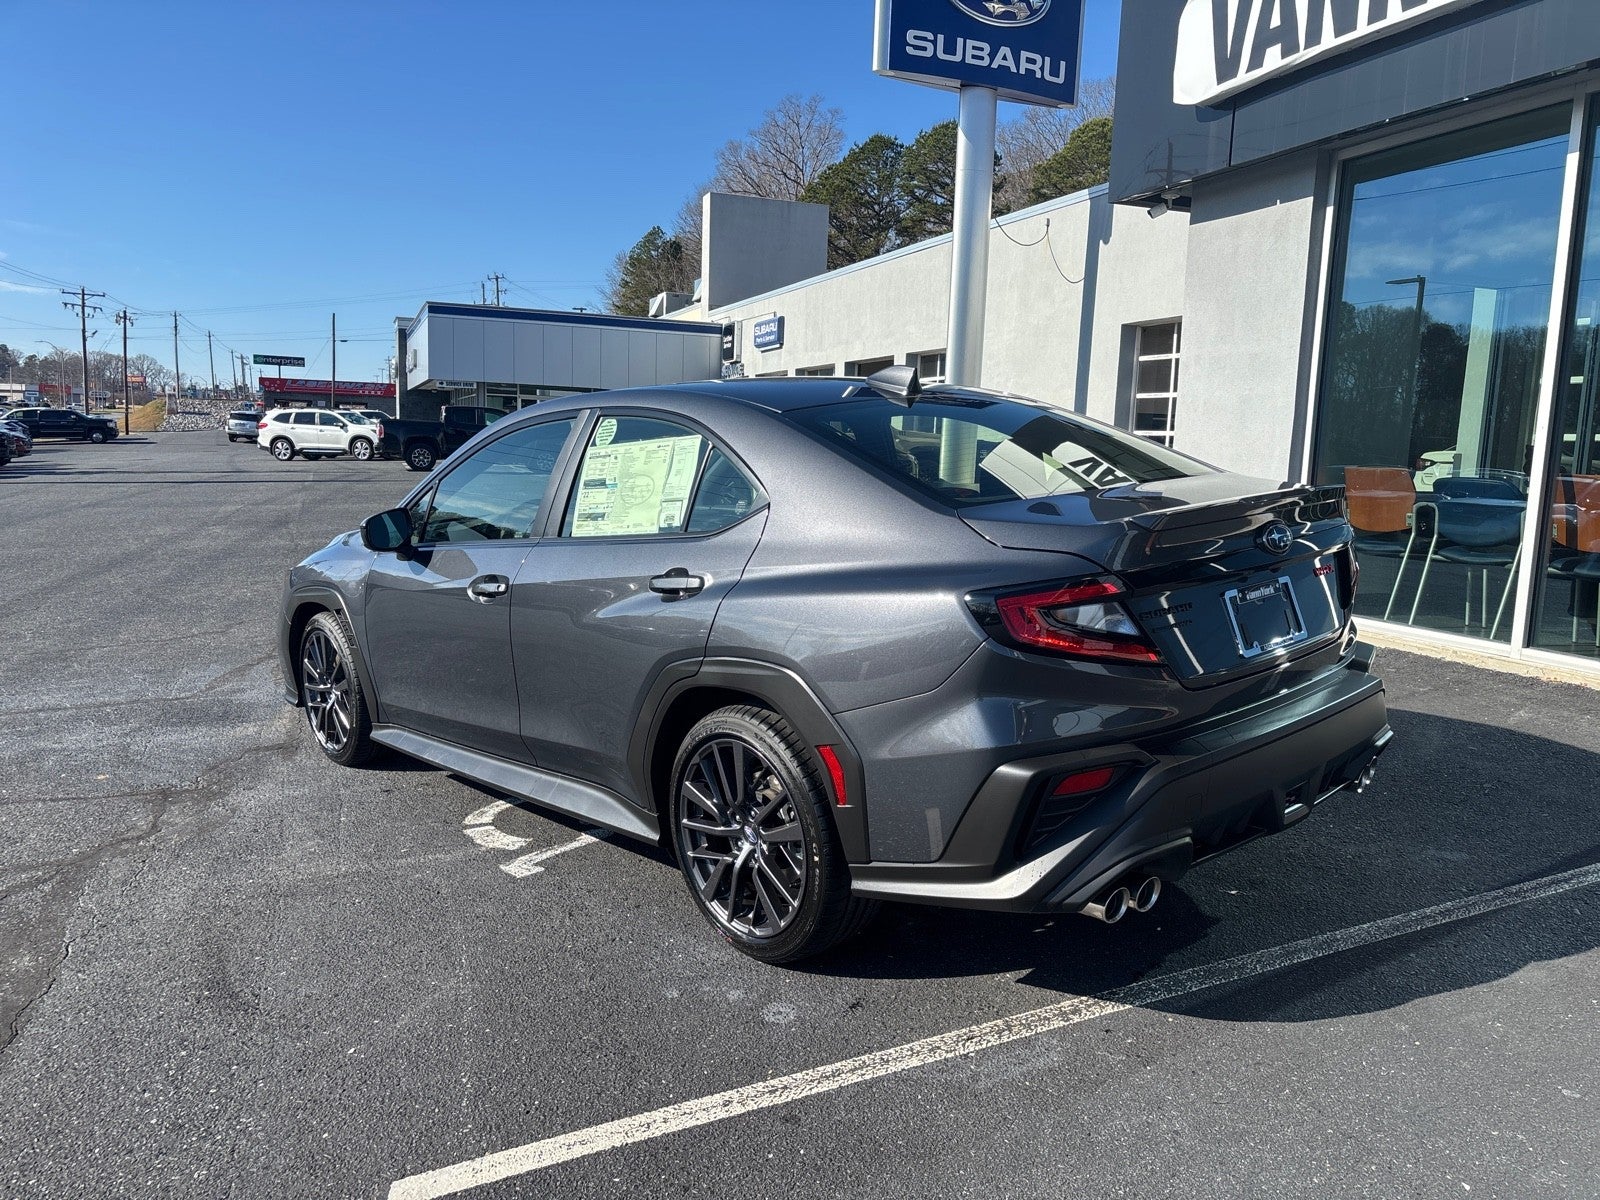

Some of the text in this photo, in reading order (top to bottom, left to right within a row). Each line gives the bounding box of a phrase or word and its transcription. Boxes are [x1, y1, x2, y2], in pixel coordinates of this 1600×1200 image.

[905, 29, 1066, 84] SUBARU
[1211, 0, 1428, 86] VA
[754, 322, 778, 336] SUBARU
[255, 354, 305, 366] enterprise
